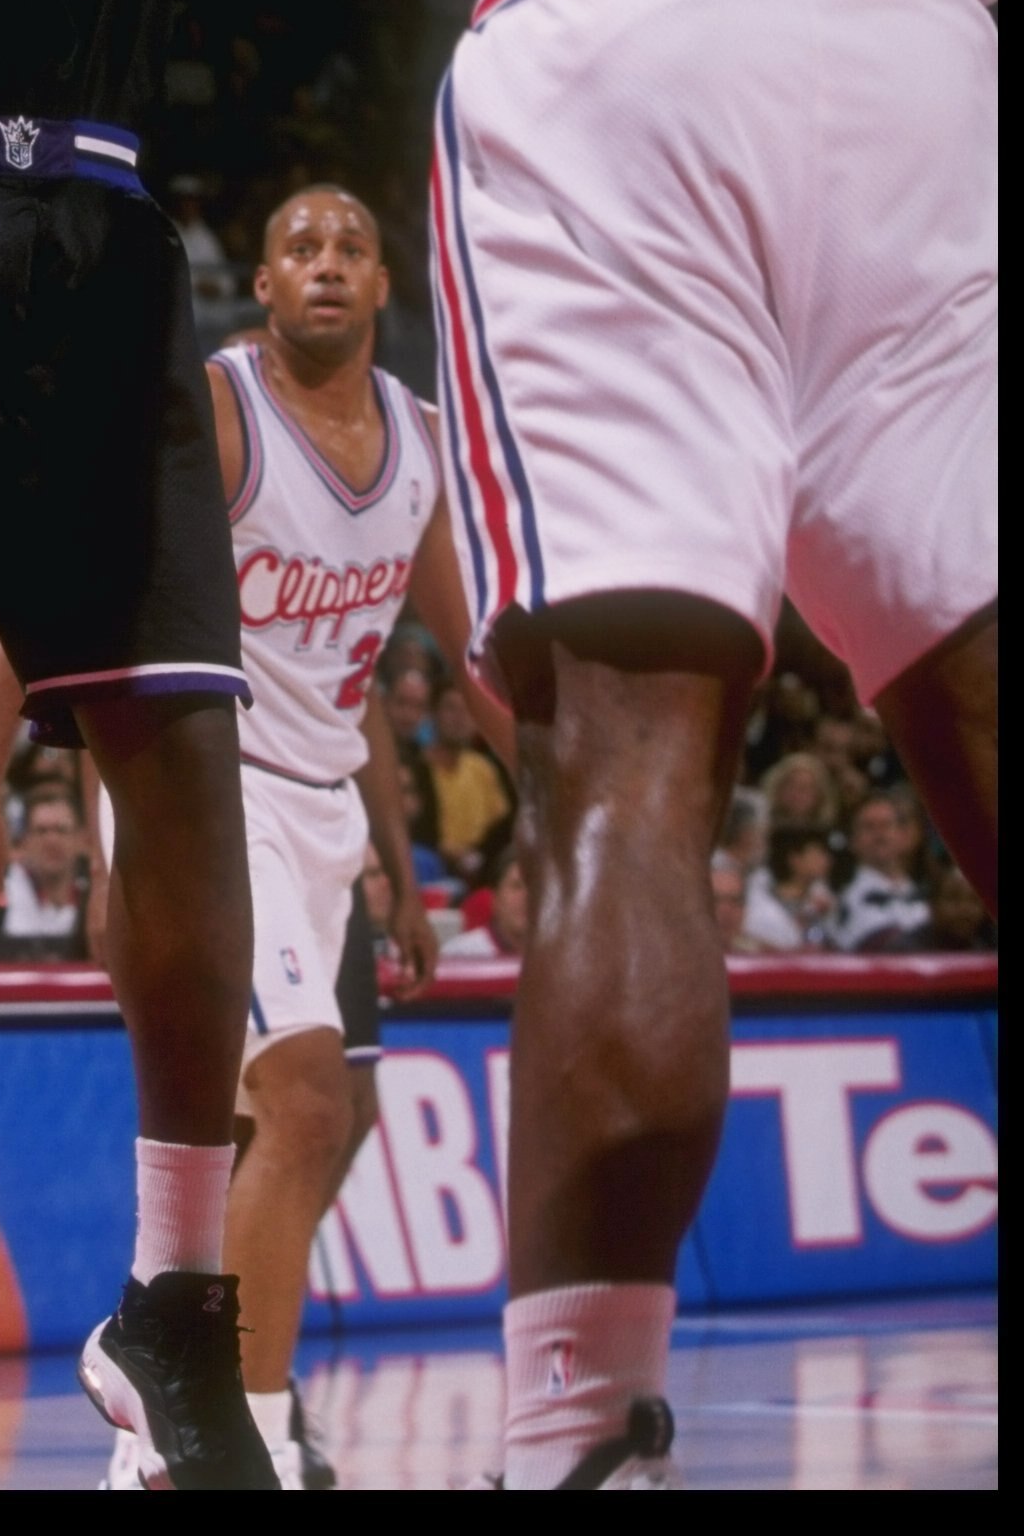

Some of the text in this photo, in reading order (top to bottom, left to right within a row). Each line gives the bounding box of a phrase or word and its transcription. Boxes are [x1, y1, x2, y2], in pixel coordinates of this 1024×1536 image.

[306, 1035, 998, 1301] NB Te
[202, 1284, 225, 1313] 2
